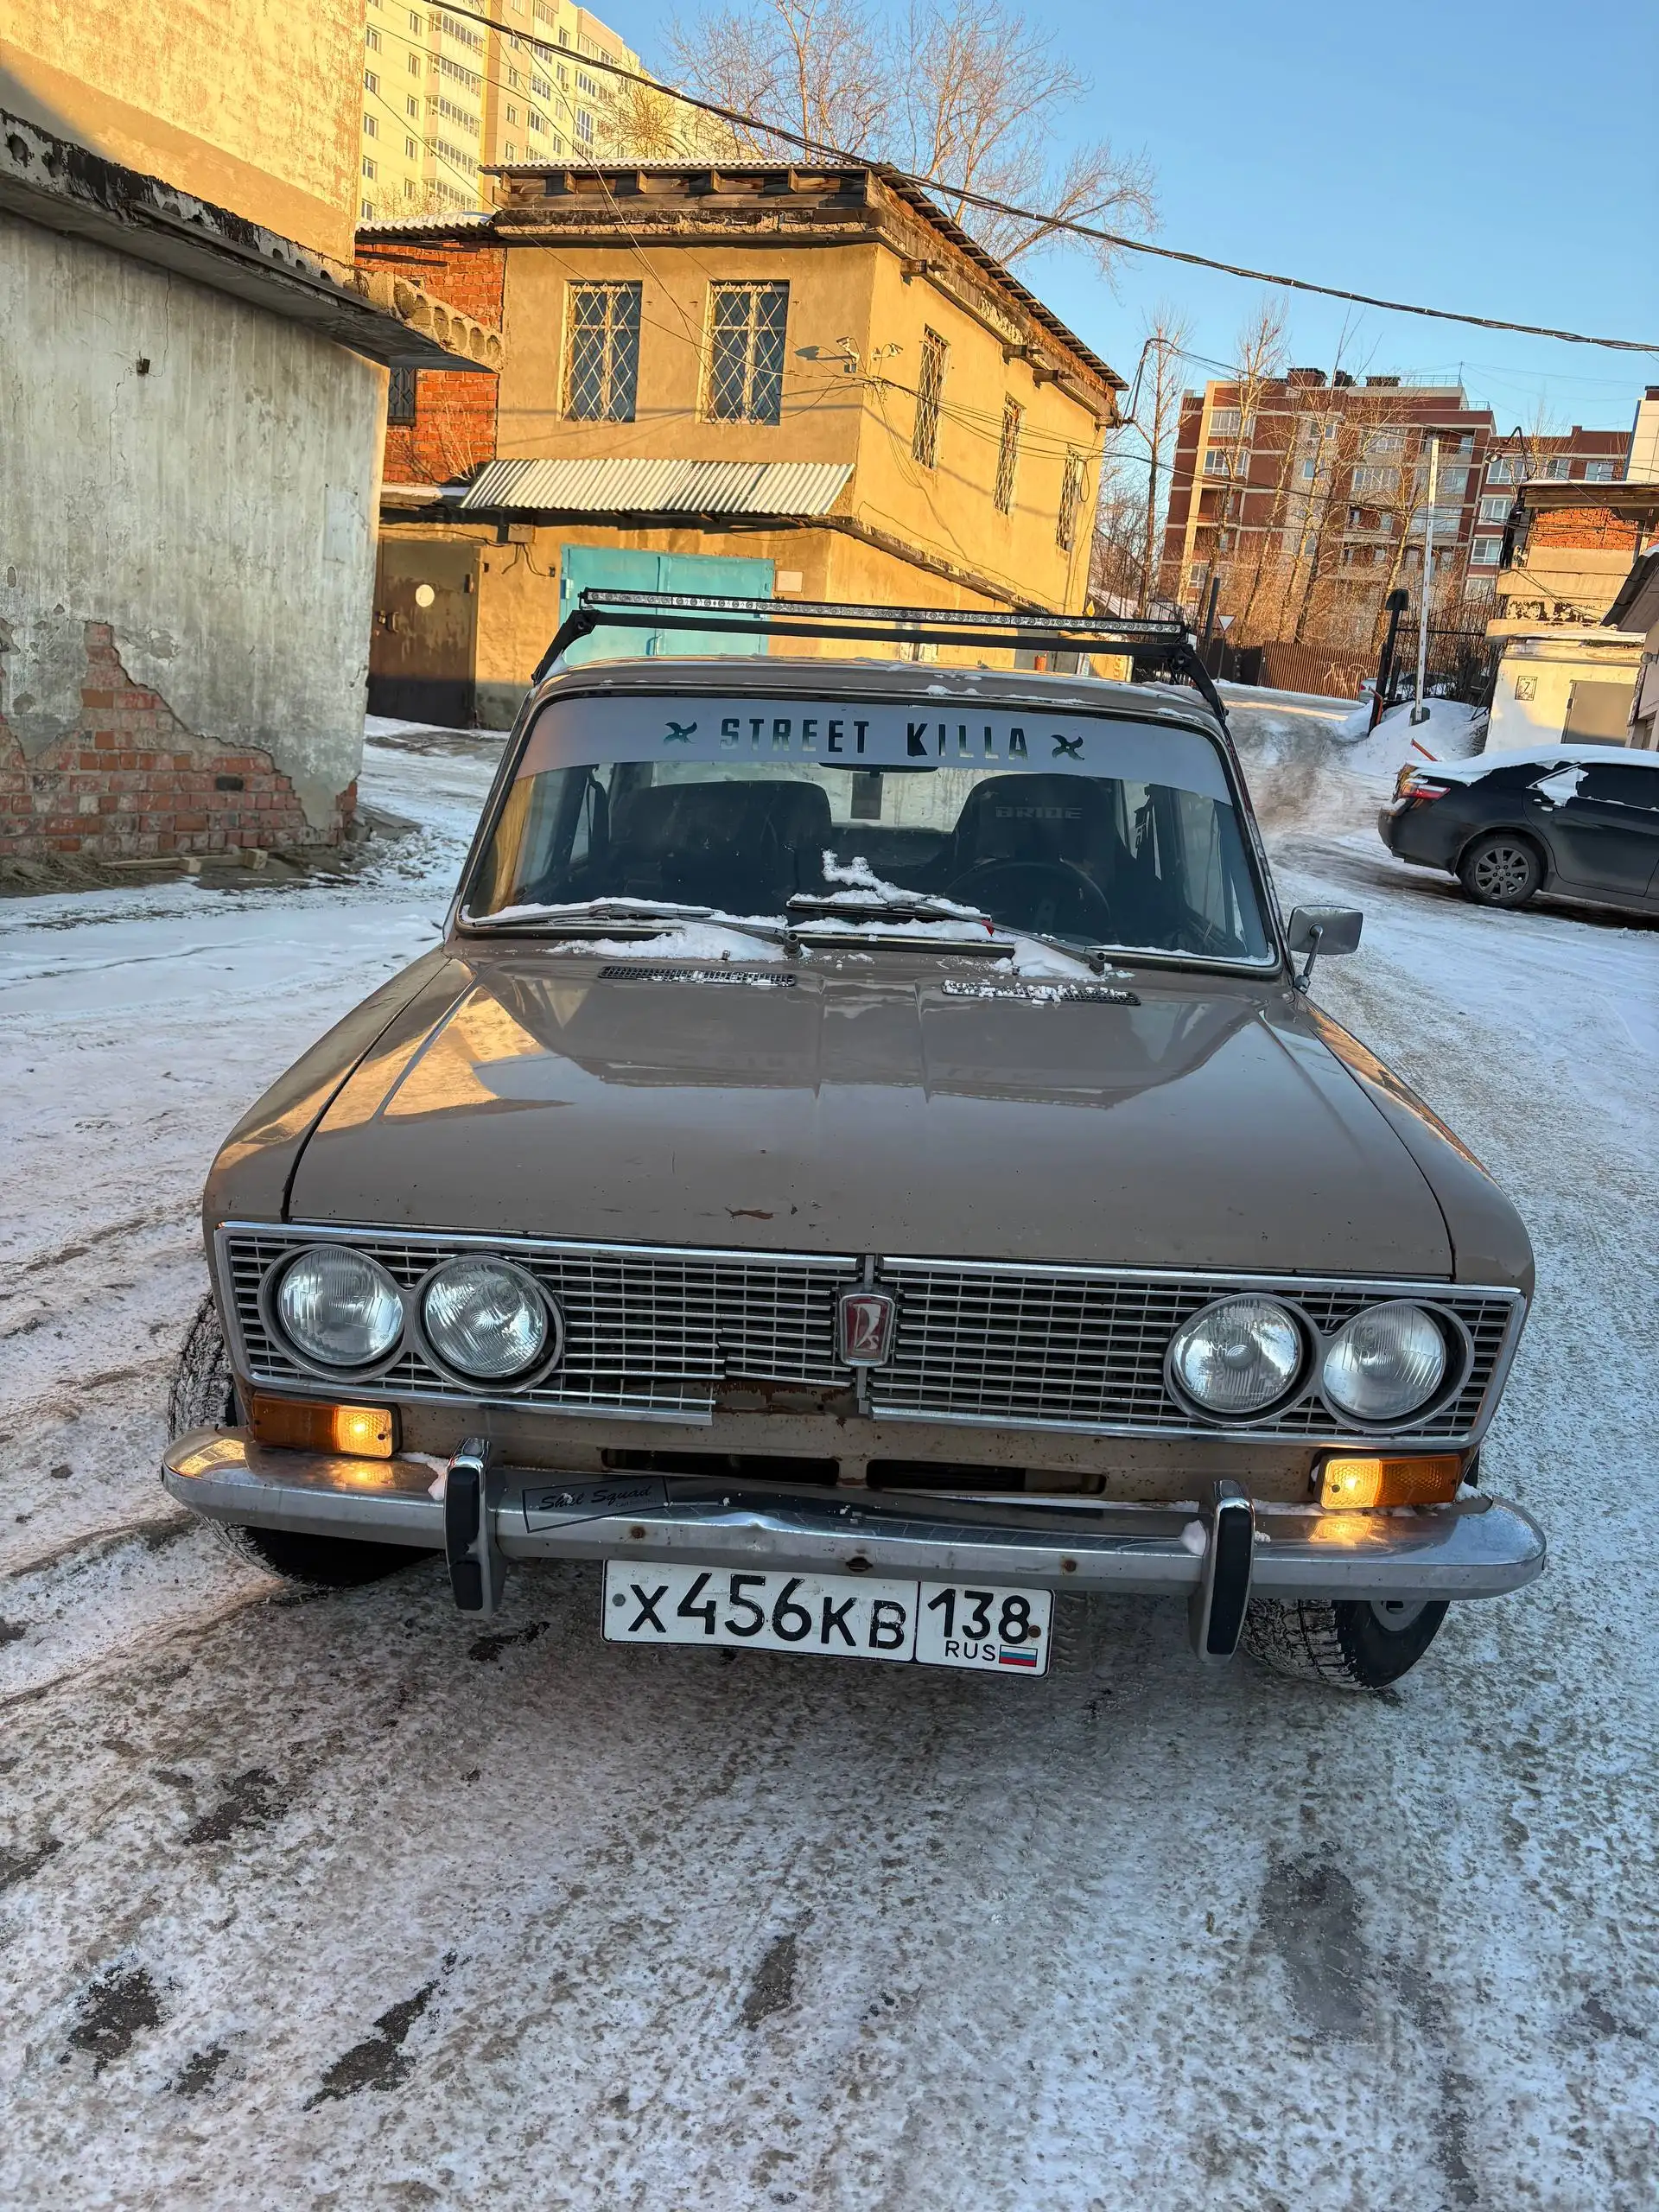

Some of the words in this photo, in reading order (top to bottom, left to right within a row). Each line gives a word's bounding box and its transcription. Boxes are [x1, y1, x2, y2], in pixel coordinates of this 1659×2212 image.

[720, 718, 869, 752] STREET
[907, 722, 1029, 760] KILLA
[995, 806, 1083, 819] BRIDE
[590, 1484, 652, 1506] Squad
[927, 1588, 1032, 1644] 138
[944, 1640, 996, 1662] RUS
